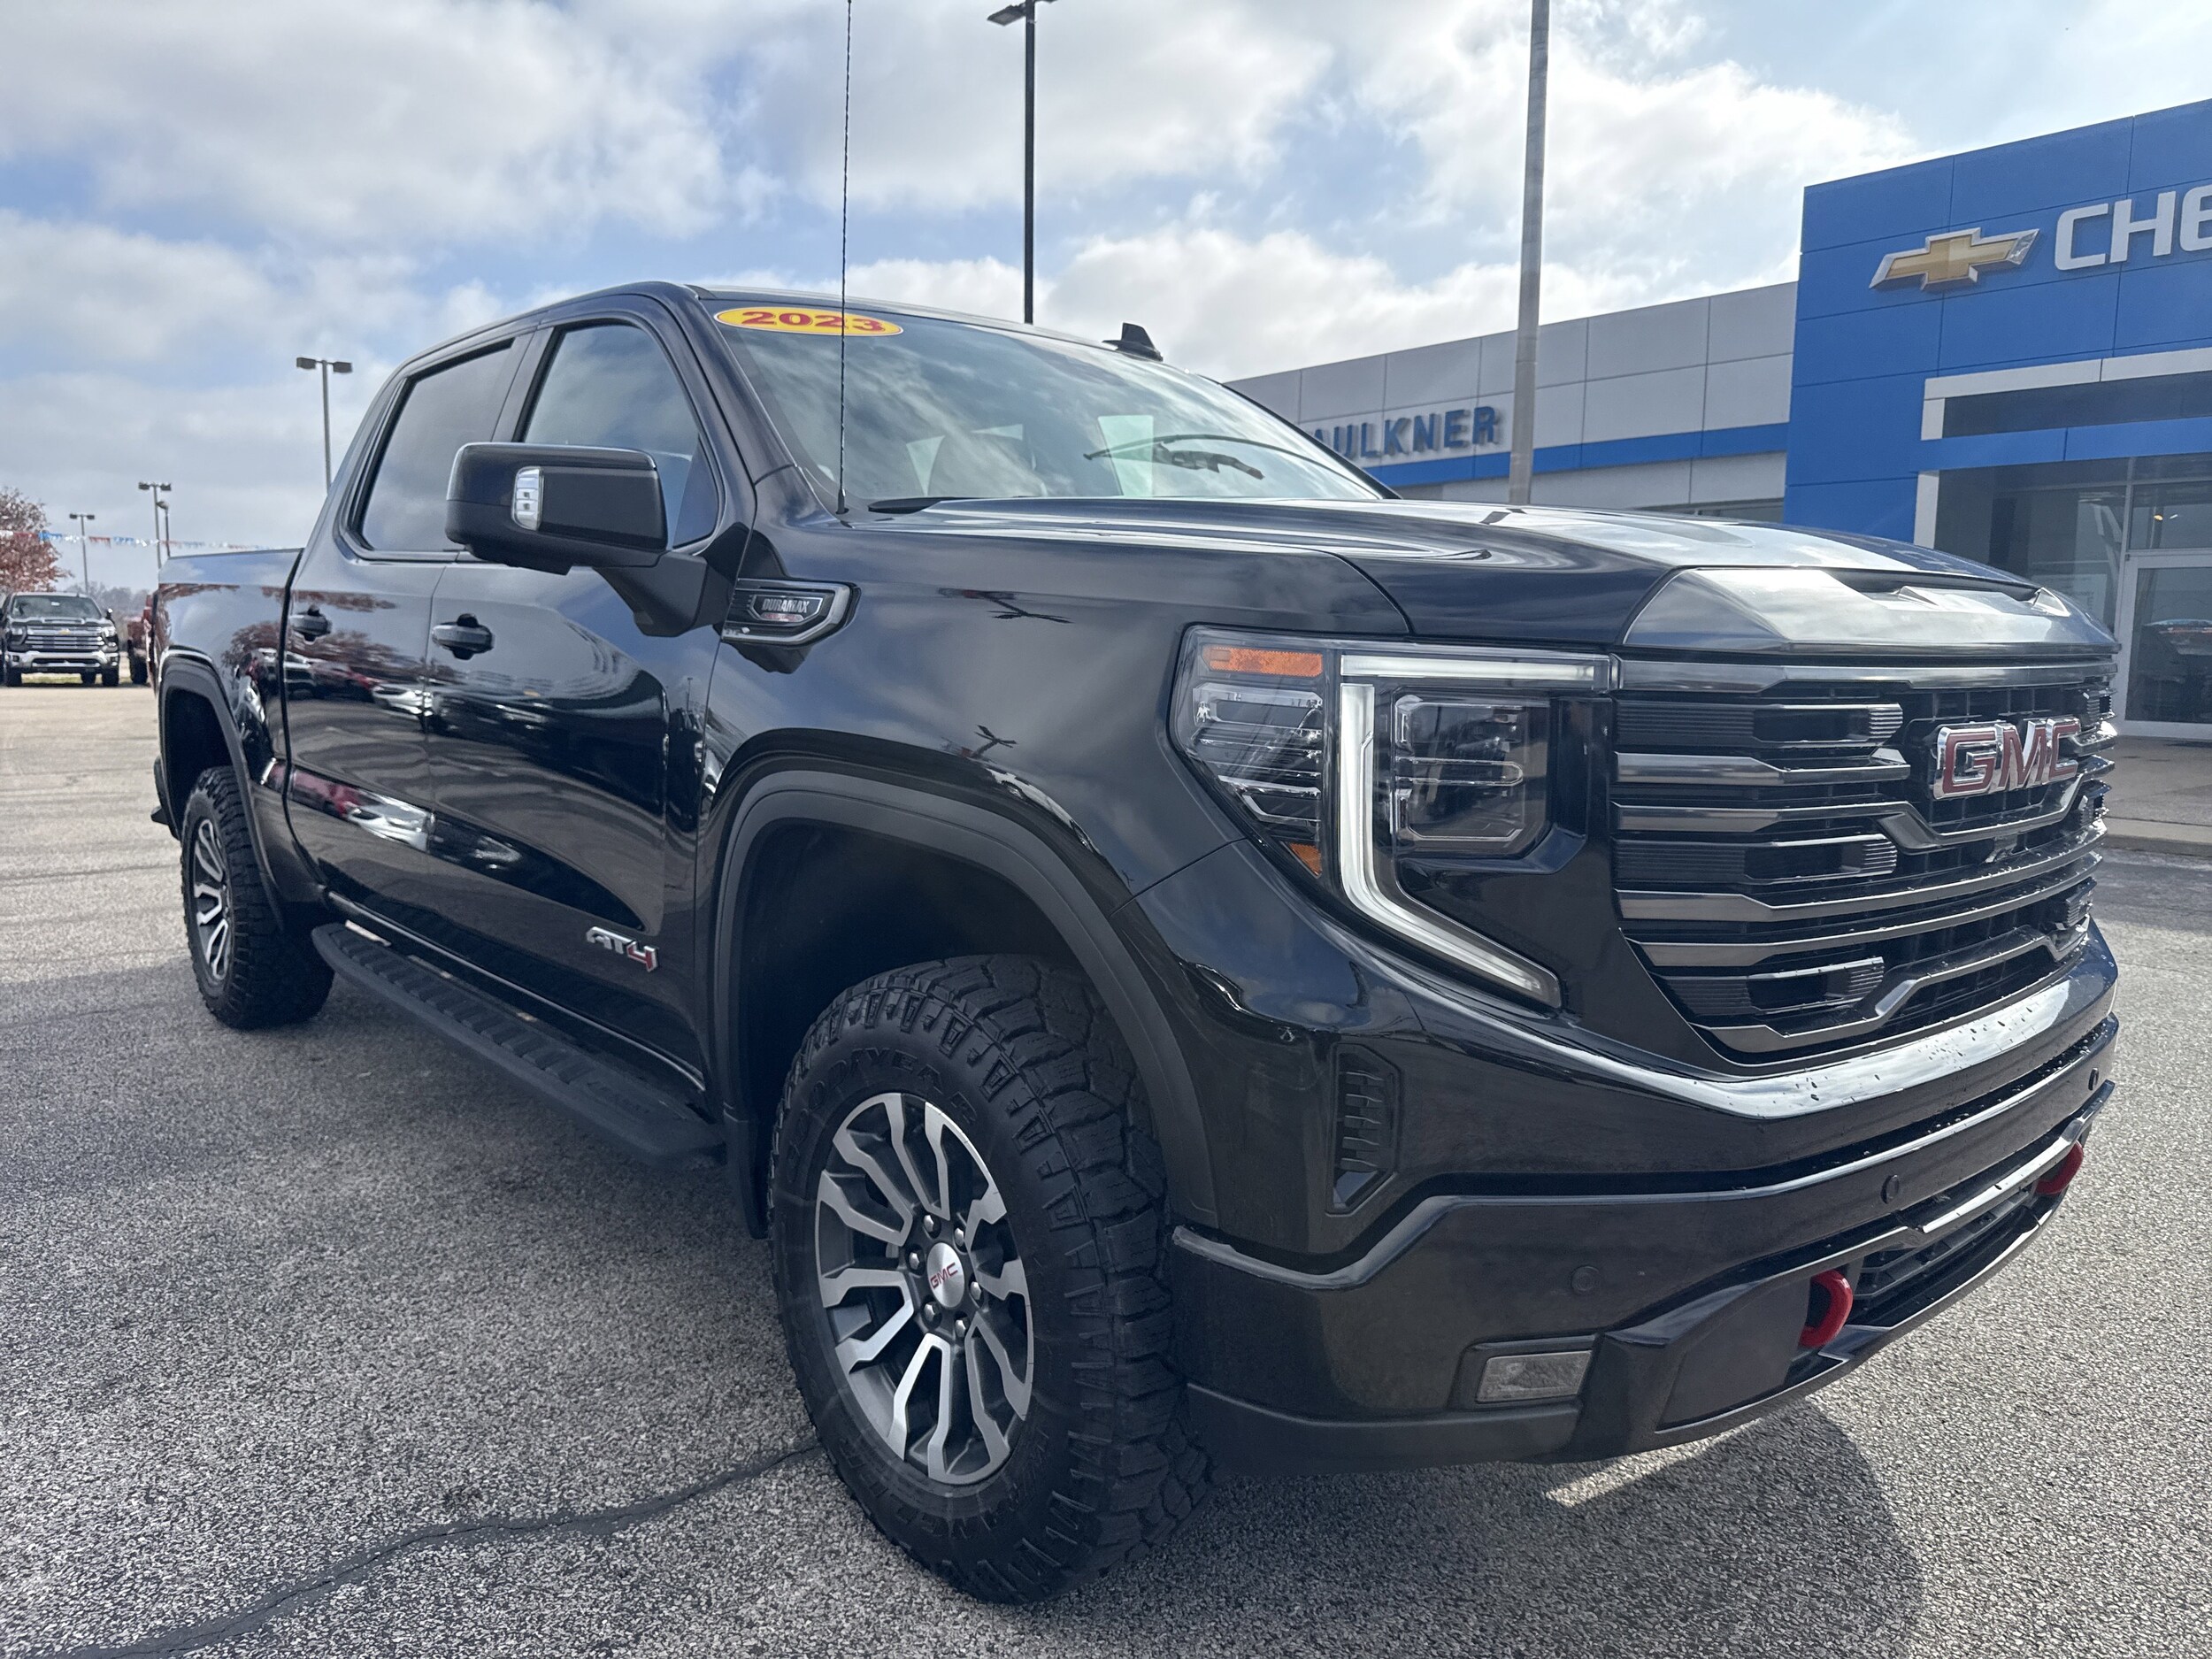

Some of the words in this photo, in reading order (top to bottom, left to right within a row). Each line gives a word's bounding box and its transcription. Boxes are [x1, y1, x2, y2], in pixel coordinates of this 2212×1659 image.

[2055, 184, 2212, 271] CHE
[741, 311, 886, 332] 2023
[1314, 405, 1497, 458] ULKNER
[761, 598, 810, 613] DURAMAX
[1934, 718, 2081, 800] GMC
[586, 926, 658, 972] AT4
[930, 1262, 958, 1289] GMC
